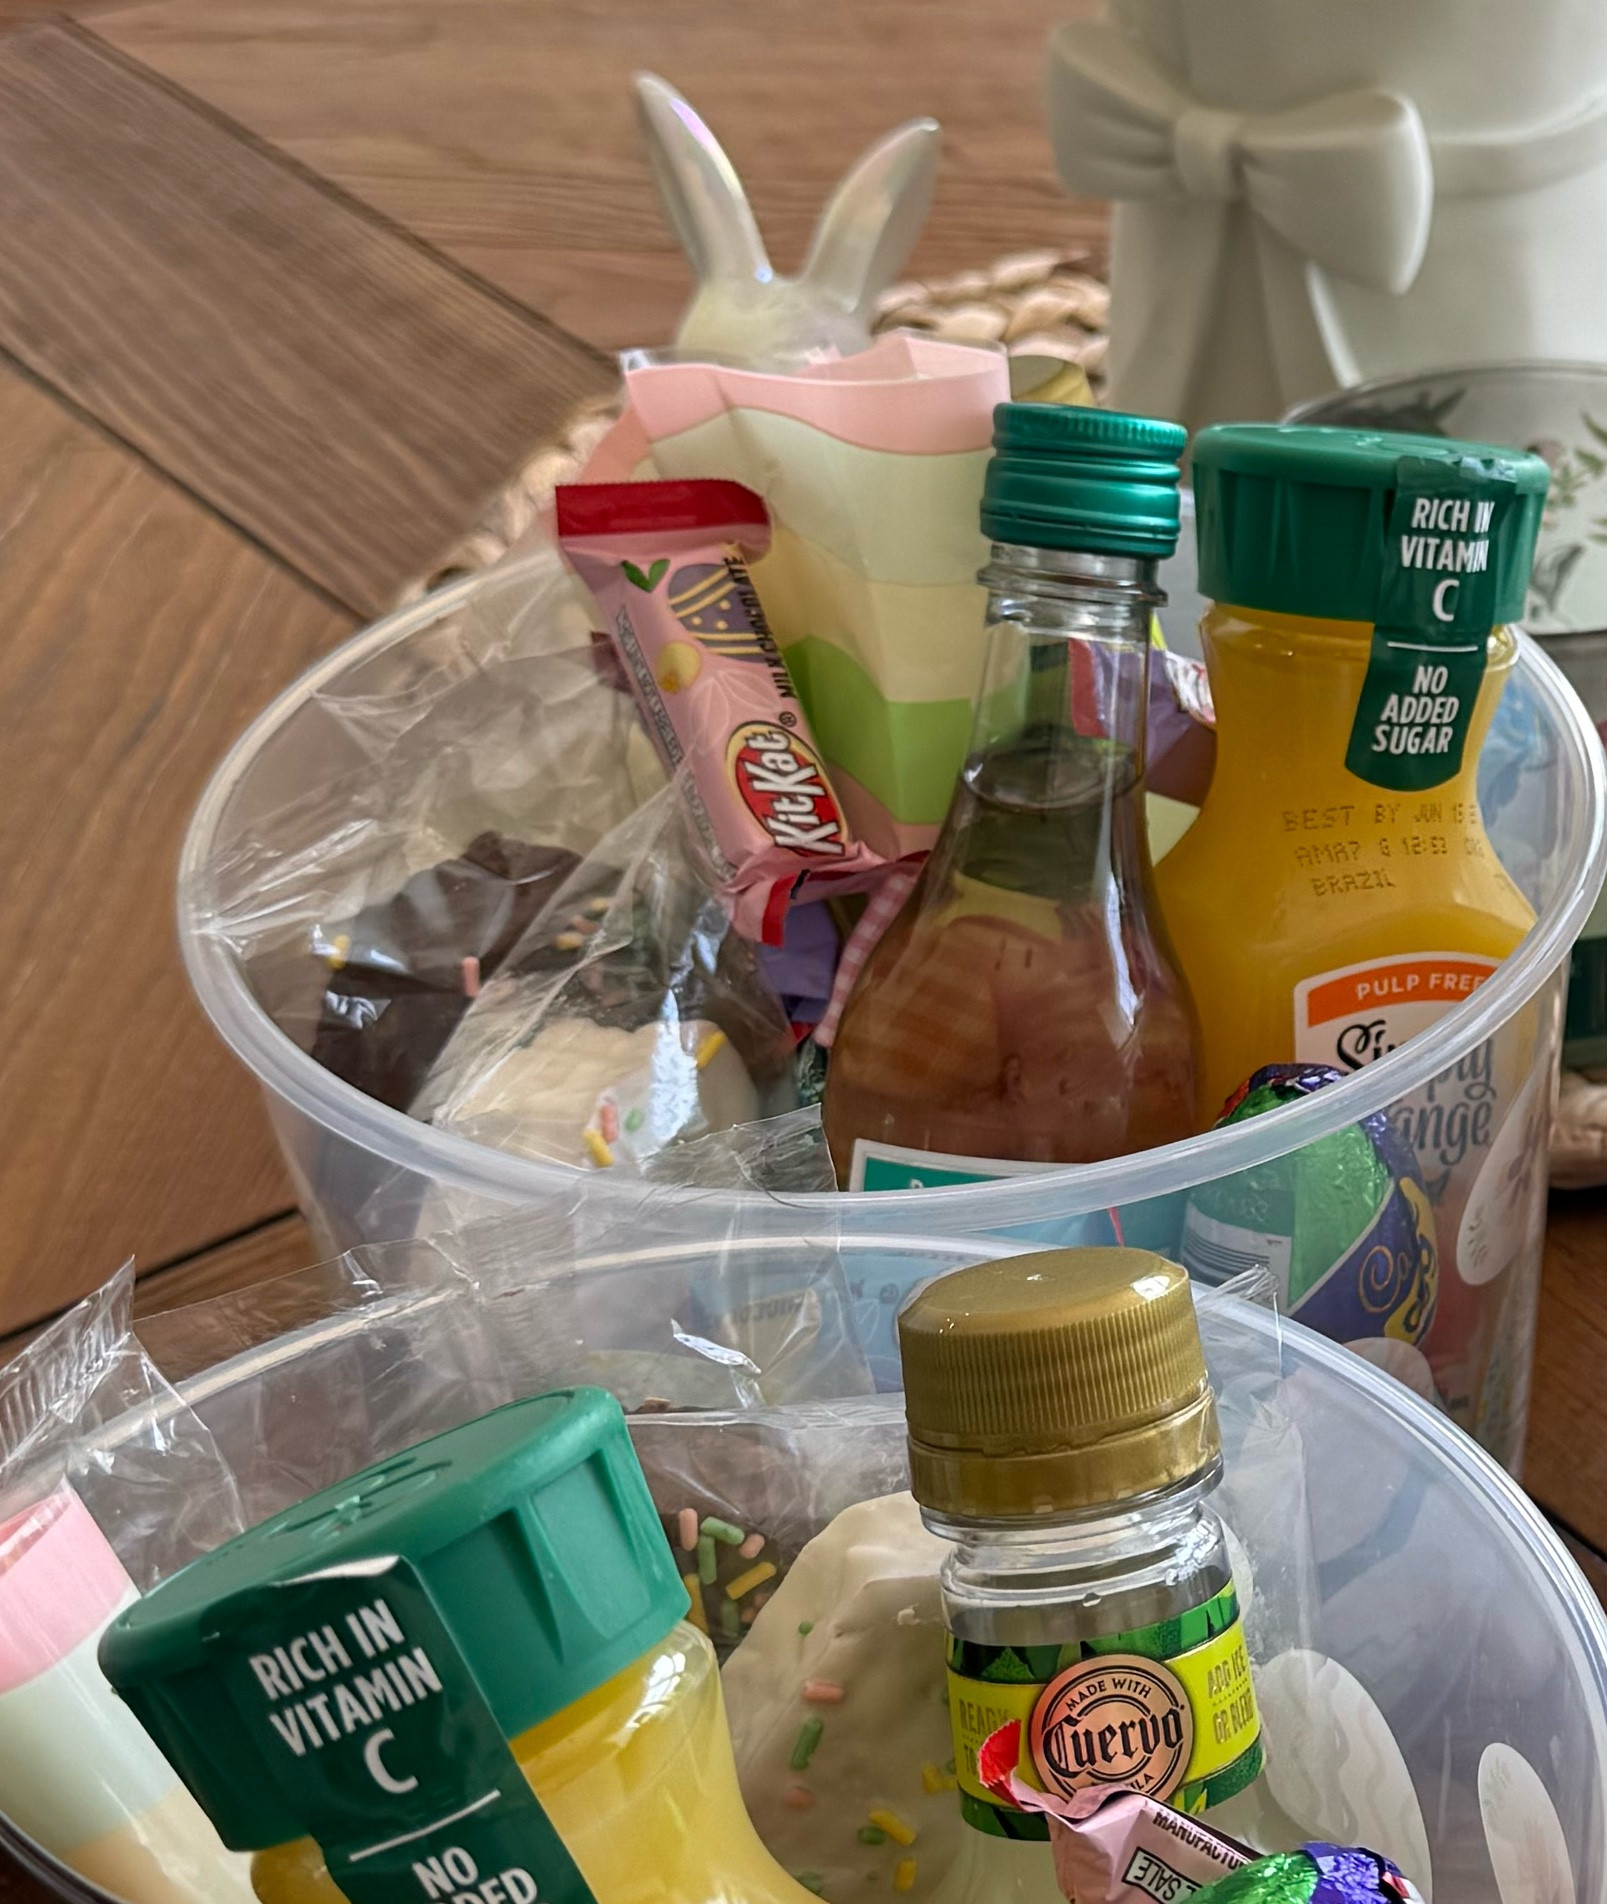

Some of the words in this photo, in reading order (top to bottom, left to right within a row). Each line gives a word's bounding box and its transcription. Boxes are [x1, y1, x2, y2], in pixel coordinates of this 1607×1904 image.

[1412, 498, 1468, 532] RICH
[1475, 501, 1495, 534] IN
[1401, 536, 1490, 573] VITAMIN
[1433, 579, 1460, 622] C
[1413, 665, 1448, 694] NO
[1381, 694, 1459, 725] ADDED
[1371, 725, 1453, 755] SUGAR
[744, 730, 846, 857] KitKat
[1355, 974, 1420, 1000] PULP
[248, 1624, 352, 1701] RICH
[345, 1598, 405, 1658] IN
[269, 1646, 443, 1757] VITAMIN
[1065, 1679, 1107, 1712] MADE
[1111, 1677, 1152, 1699] WITH
[364, 1727, 418, 1795] C
[1043, 1707, 1184, 1780] Cuervo
[411, 1846, 479, 1898] NO
[1134, 1856, 1182, 1901] SALE
